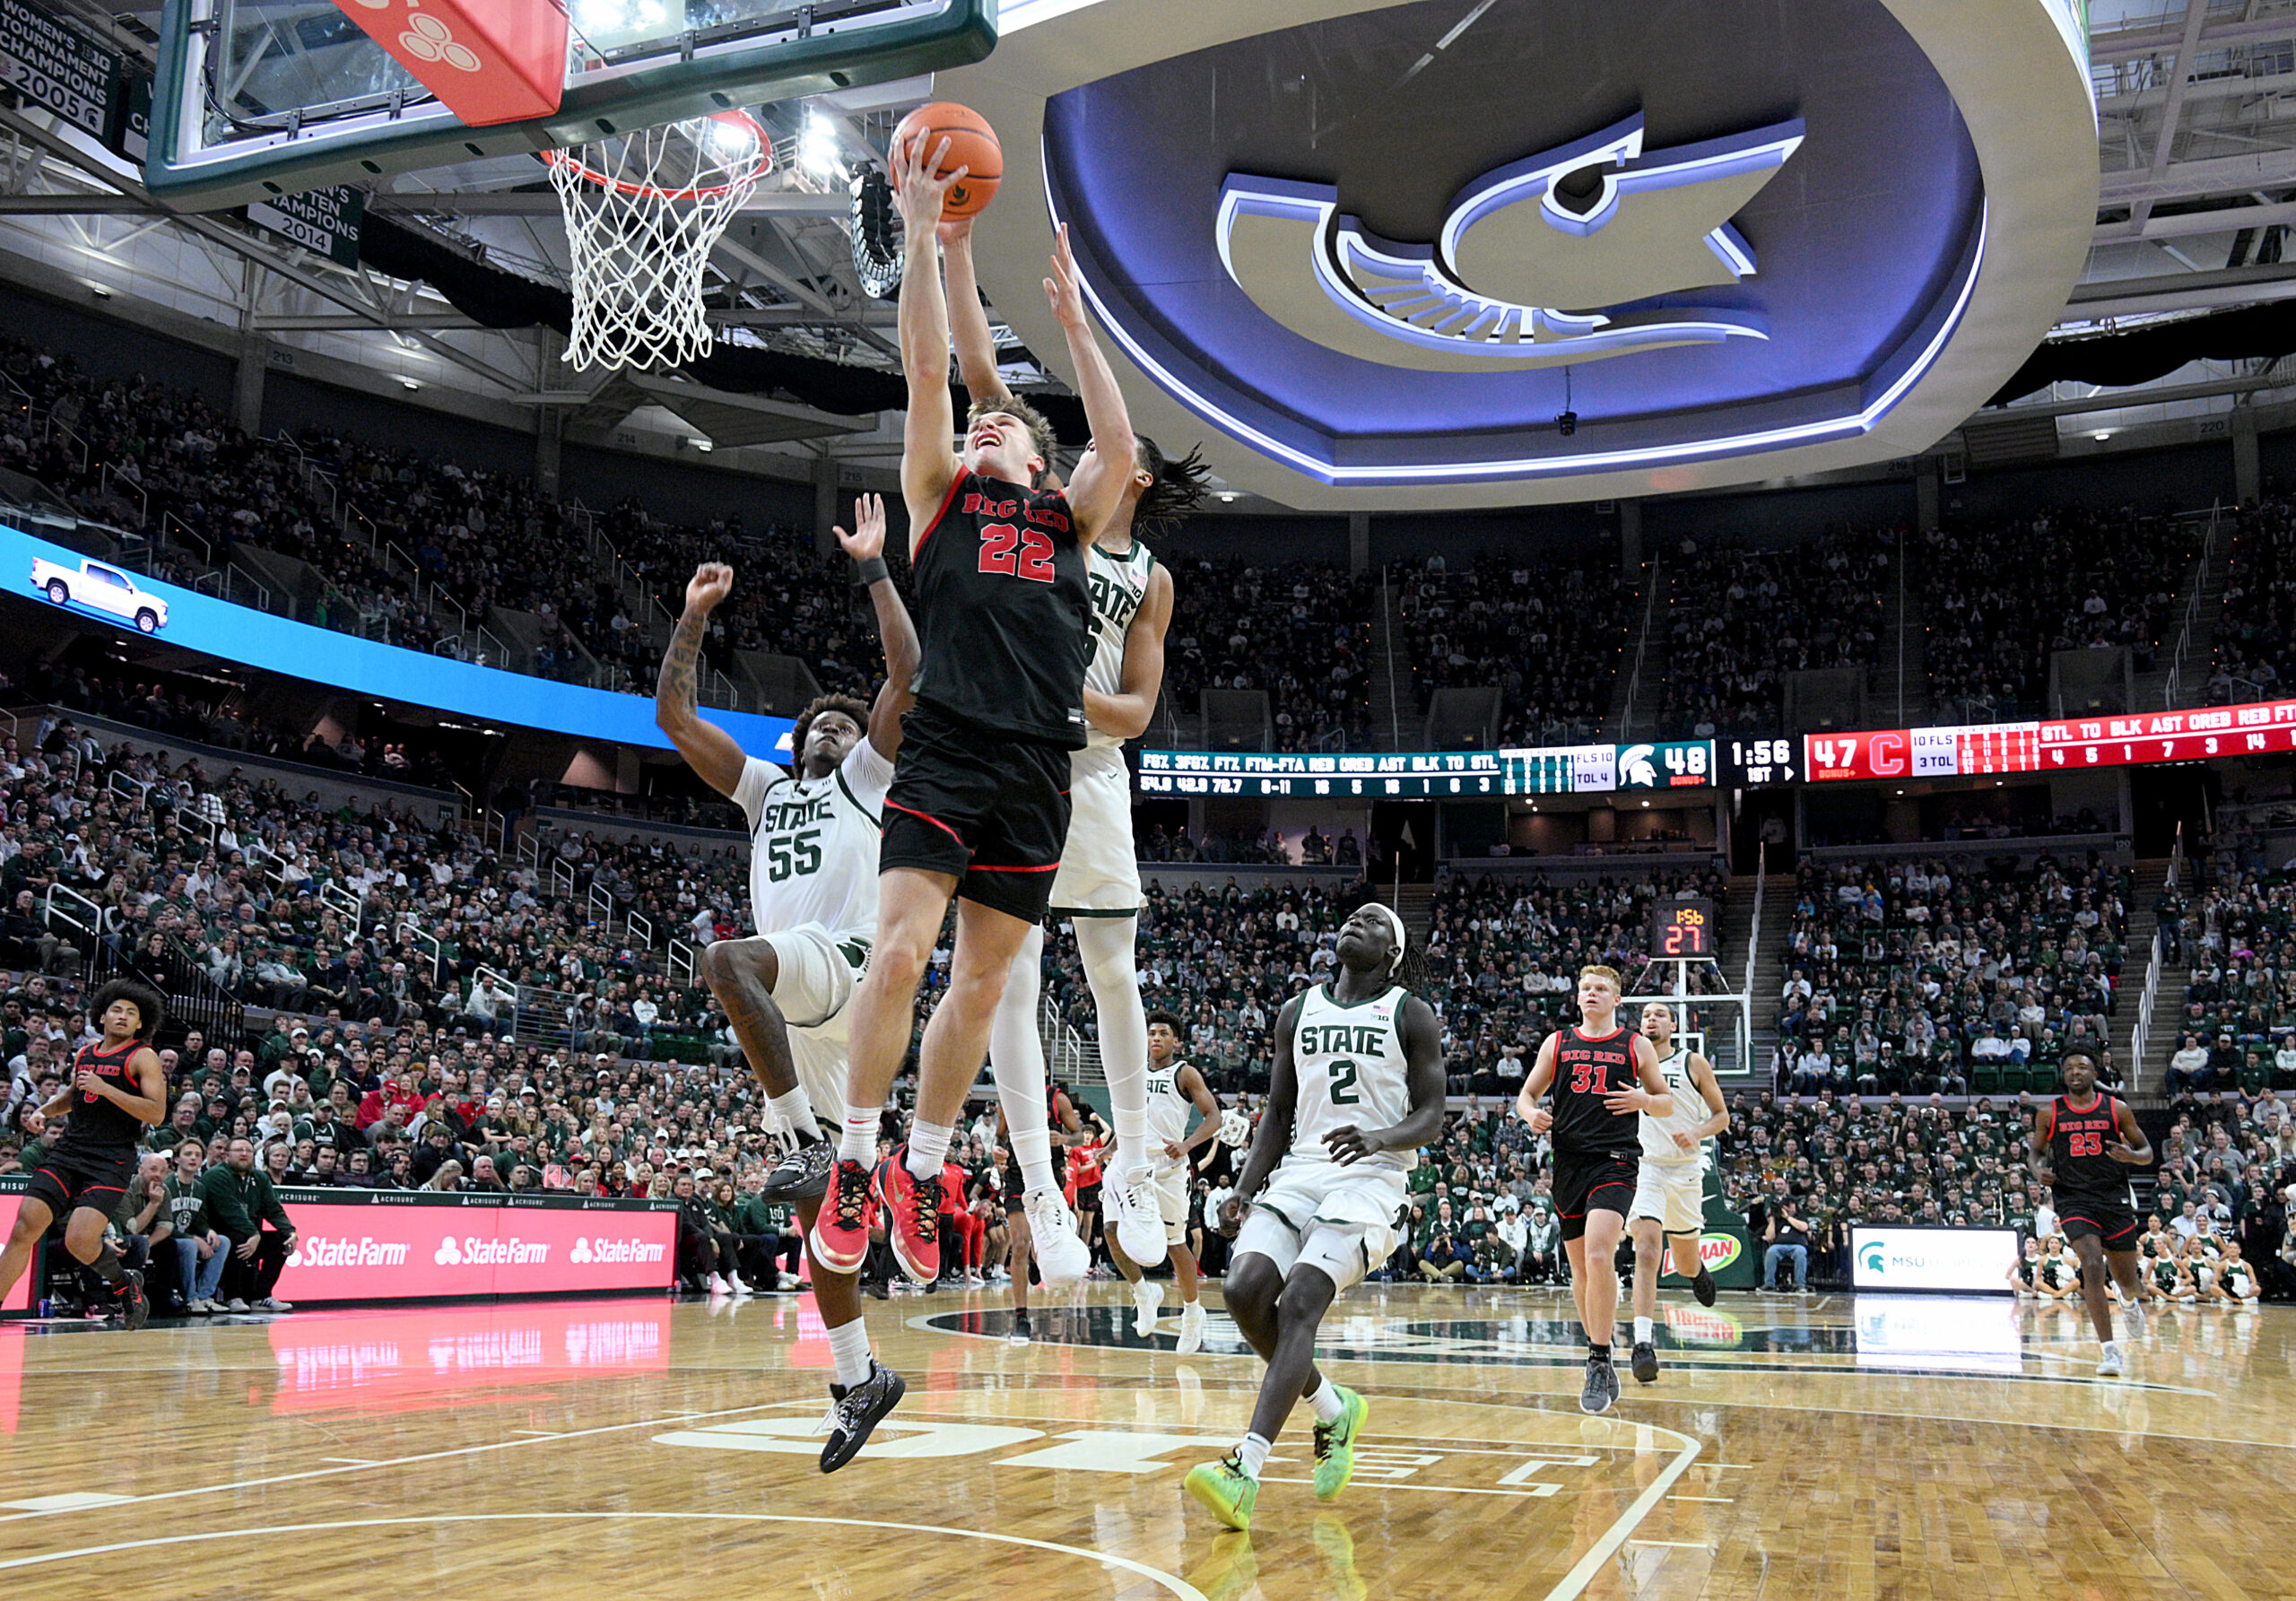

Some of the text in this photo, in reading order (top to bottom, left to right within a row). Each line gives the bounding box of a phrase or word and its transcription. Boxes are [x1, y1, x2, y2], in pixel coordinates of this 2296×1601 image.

[4, 0, 75, 50] WOMEN'S
[1, 12, 109, 86] TOURNAMENT
[0, 30, 107, 105] CHAMPIONS
[16, 65, 80, 117] 2005
[309, 191, 341, 217] TEN
[283, 217, 326, 249] 2014
[273, 351, 294, 365] 213
[617, 432, 636, 444] 214
[2200, 421, 2224, 433] 220
[844, 471, 862, 483] 215
[961, 492, 1018, 518] BIG
[978, 523, 1055, 584] 22
[2042, 725, 2073, 742] STL
[2080, 722, 2101, 739] TO
[2110, 719, 2142, 736] BLK
[2150, 716, 2183, 734] AST
[2189, 711, 2231, 730] OREB
[2238, 707, 2271, 726] REB
[1732, 739, 1790, 765] 1:56
[1814, 738, 1857, 769] 47
[1913, 735, 1926, 746] 10
[1930, 735, 1953, 746] FLS
[2051, 733, 2266, 765] 4 5 1 7 3 14
[1214, 756, 1240, 771] FT%
[1246, 756, 1305, 772] FTM-FTA
[1309, 757, 1335, 772] REB
[1378, 757, 1406, 772] AST
[1412, 756, 1440, 772] BLK
[1446, 755, 1465, 770] TO
[1471, 755, 1499, 770] STL
[1577, 752, 1613, 763] FLS 10
[1665, 746, 1707, 775] 48
[1869, 734, 1905, 775] C
[1919, 756, 1953, 767] 3 TOL
[1213, 778, 1242, 794] 72.7
[1351, 779, 1362, 795] 5
[1422, 779, 1431, 794] 1
[1479, 777, 1490, 792] 3
[1577, 772, 1608, 784] TOL 4
[1747, 766, 1772, 782] 1ST
[765, 790, 836, 833] STATE
[769, 828, 822, 883] 55
[1676, 908, 1704, 926] 1:56
[1665, 925, 1700, 955] 27
[1301, 1025, 1388, 1058] STATE
[1561, 1049, 1626, 1065] BIG RED
[1328, 1059, 1360, 1105] 2
[1570, 1063, 1608, 1095] 31
[2069, 1132, 2103, 1157] 23
[1, 1182, 28, 1190] RISU
[280, 1194, 317, 1202] ACRISURE
[515, 1198, 544, 1206] ACRISURE
[1892, 1257, 1925, 1267] MSU
